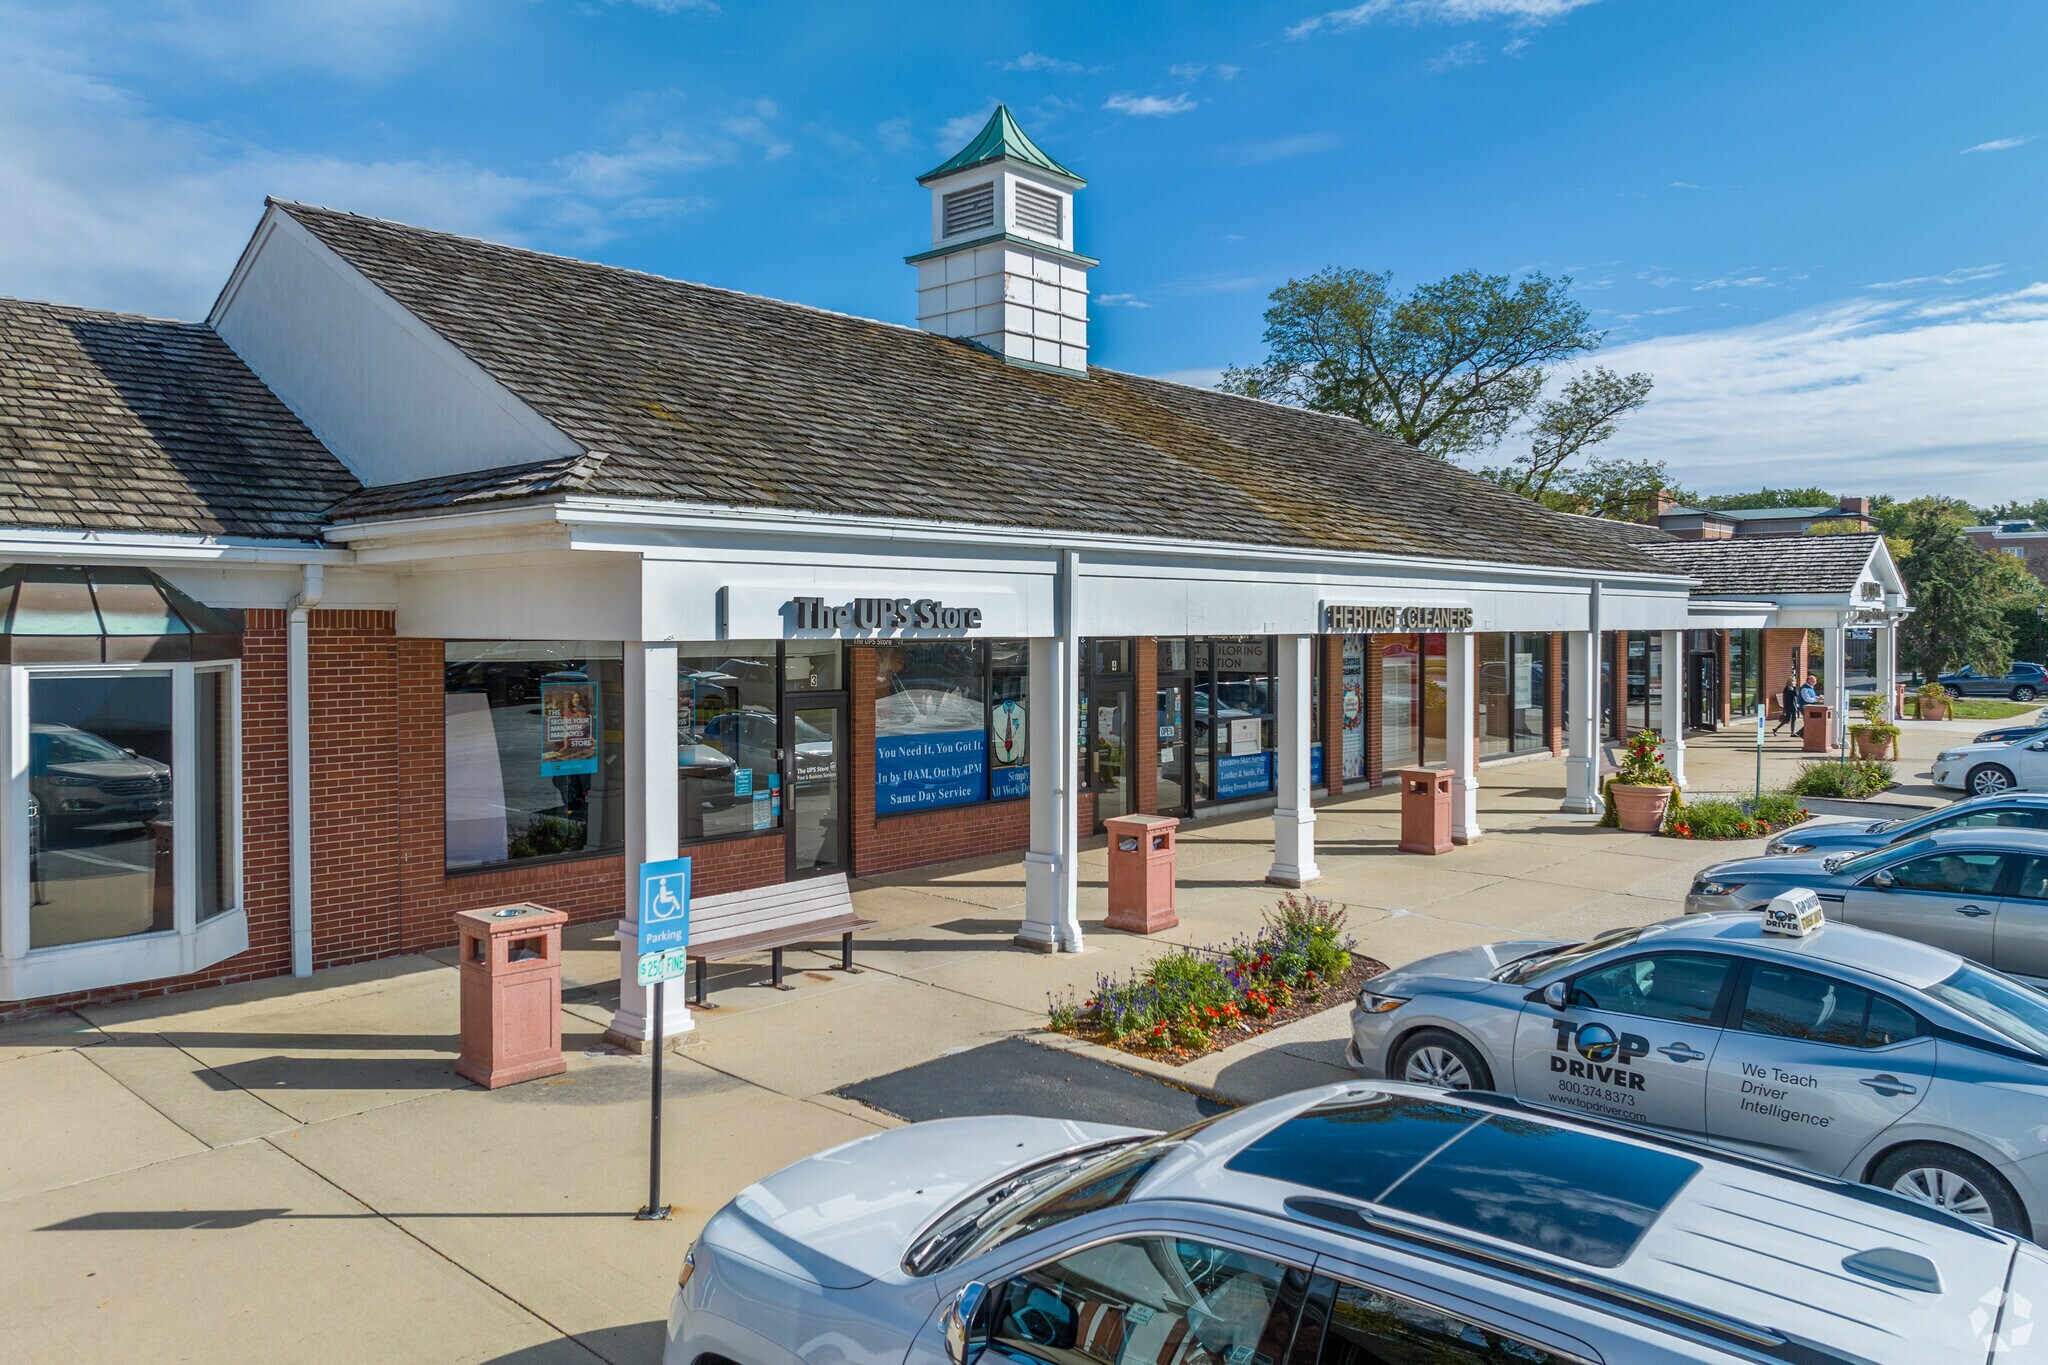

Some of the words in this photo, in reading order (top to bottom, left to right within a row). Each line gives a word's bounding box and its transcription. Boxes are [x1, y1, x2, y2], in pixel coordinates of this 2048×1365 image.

[794, 597, 849, 629] The
[854, 598, 914, 629] UPS
[915, 599, 982, 629] Store
[1329, 605, 1401, 629] HERITAGE
[1404, 606, 1473, 629] CLEANERS
[877, 638, 892, 646] Store
[811, 675, 817, 686] 3
[550, 730, 584, 738] MAILBOXES
[1160, 727, 1174, 736] OPEN
[878, 748, 896, 759] You
[898, 745, 922, 757] Need
[924, 744, 935, 756] It,
[936, 743, 953, 754] You
[955, 741, 973, 752] Got
[973, 740, 984, 750] It.
[1218, 757, 1240, 767] Executive
[1240, 756, 1251, 765] Shirt
[1251, 754, 1267, 763] Service
[817, 765, 830, 773] Store
[878, 772, 888, 783] In
[889, 772, 900, 784] by
[903, 768, 932, 781] 10AM,
[933, 766, 949, 778] Out
[951, 765, 962, 778] by
[963, 763, 982, 775] 4PM
[1220, 771, 1238, 780] Leather
[1257, 767, 1265, 776] Fur
[1008, 771, 1030, 783] Simply
[1002, 784, 1020, 795] Work
[1234, 781, 1247, 791] Dresses
[890, 793, 916, 805] Same
[918, 790, 937, 803] Day
[938, 786, 972, 799] Service
[1767, 910, 1797, 922] TOP
[1766, 920, 1799, 930] DRIVER
[646, 930, 682, 944] Parking
[667, 954, 685, 973] FINE
[1552, 1018, 1650, 1065] TOP
[1550, 1055, 1646, 1092] DRIVER
[1742, 1062, 1766, 1079] We
[1771, 1067, 1818, 1089] Teach
[1558, 1079, 1635, 1107] 800.374.8373
[1740, 1080, 1788, 1100] Driver
[1548, 1093, 1647, 1122] www.topdriver.com
